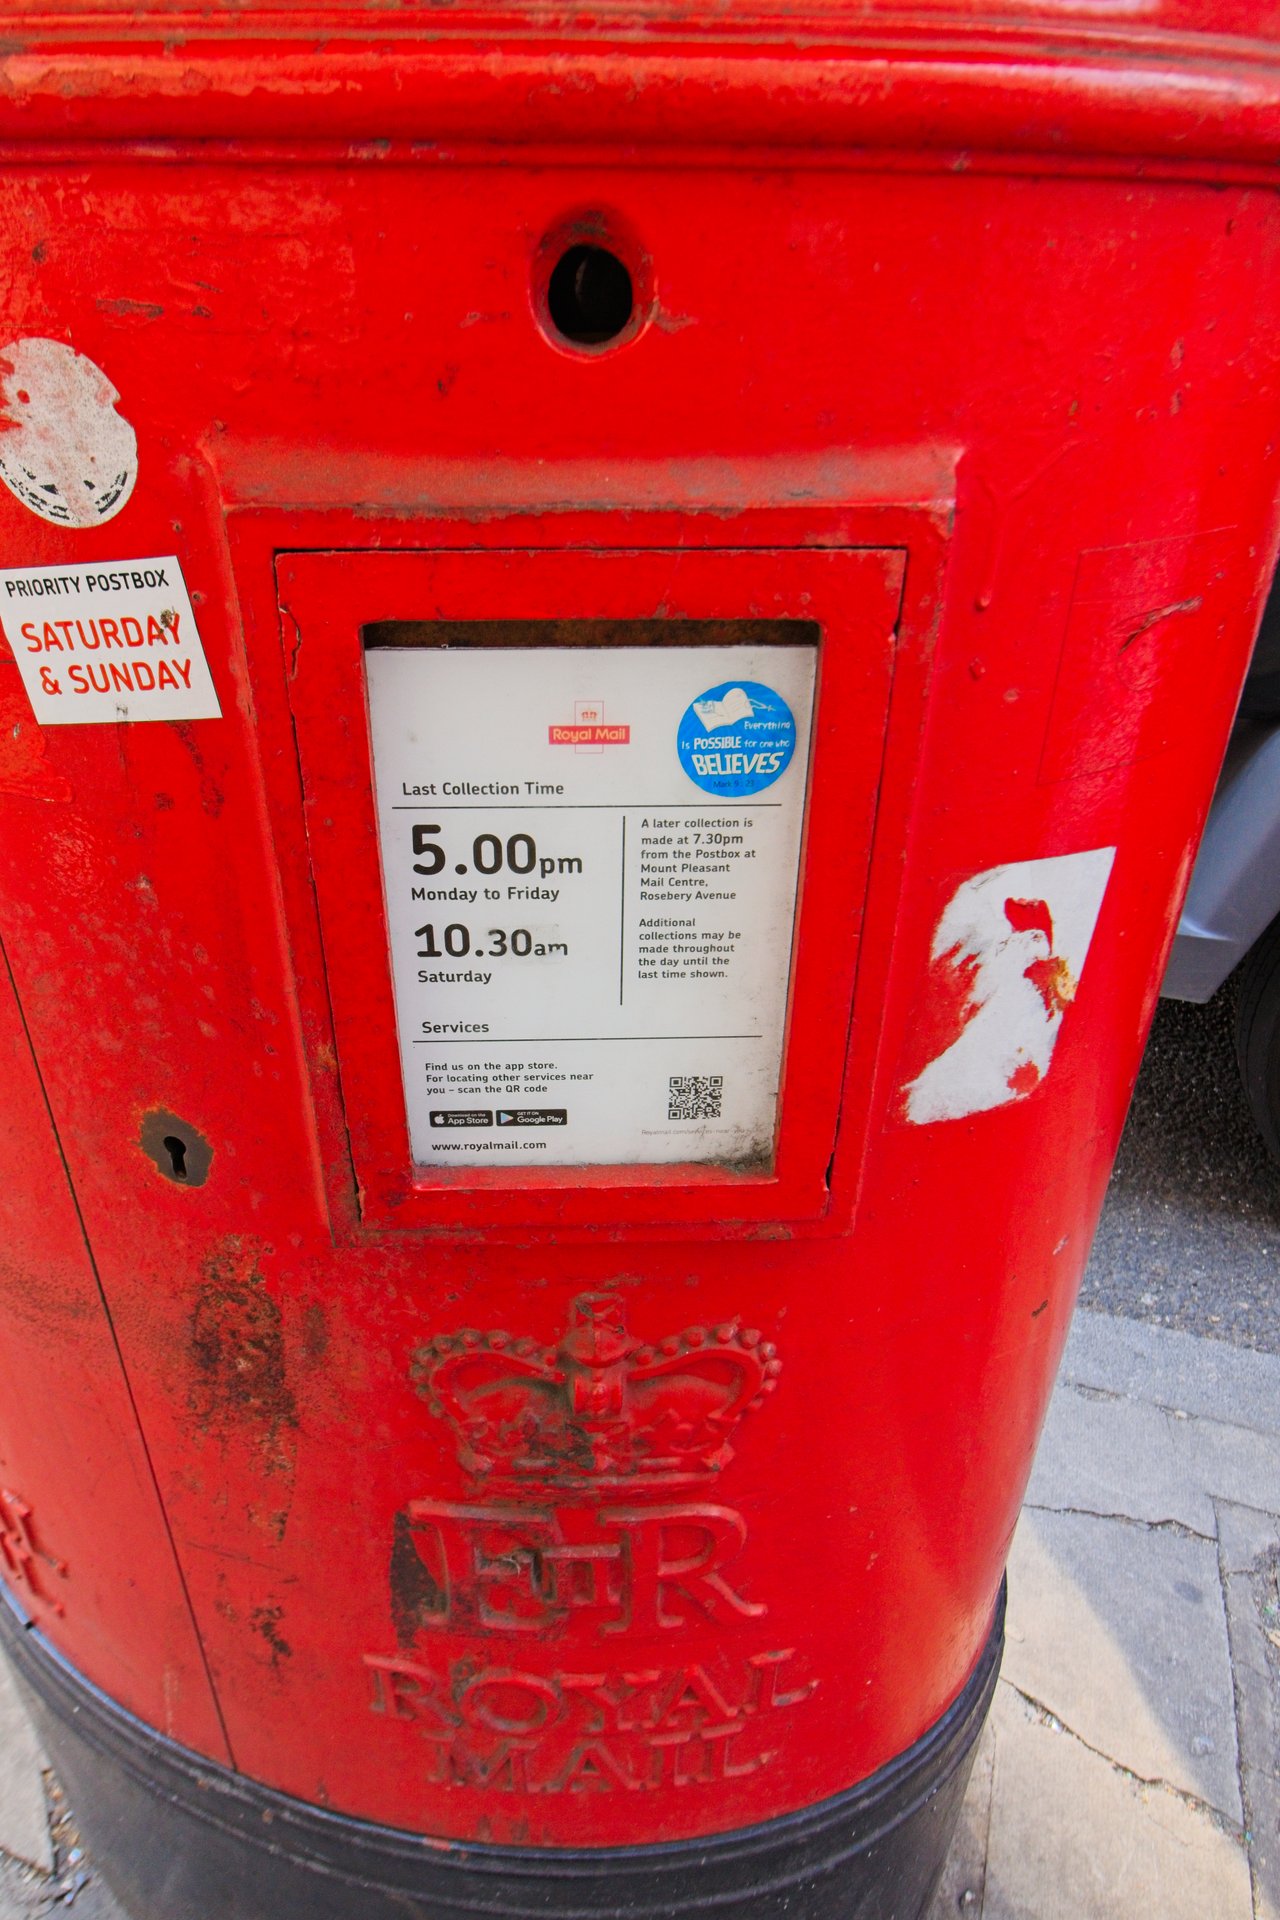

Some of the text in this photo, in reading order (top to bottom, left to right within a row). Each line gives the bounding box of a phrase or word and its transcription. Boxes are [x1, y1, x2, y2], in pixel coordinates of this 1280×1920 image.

[5, 569, 169, 597] PRIORITY POSTBOX
[21, 613, 180, 653] SATURDAY
[40, 659, 191, 695] & SUNDAY
[552, 728, 625, 742] Royal Mail
[694, 736, 742, 750] POSSIBLE
[691, 752, 784, 775] BELIEVES
[402, 782, 564, 796] Last Collection Time
[642, 818, 753, 828] A later collection is
[642, 833, 743, 846] made at 7.30pm
[412, 824, 583, 879] 5.00pm
[641, 849, 756, 859] from the Postbox at
[641, 864, 730, 873] Mount Pleasant
[641, 877, 708, 887] Mail Centre,
[411, 886, 560, 903] Monday to Friday
[640, 891, 736, 902] Rosebery Avenue
[639, 918, 696, 927] Additional
[414, 923, 568, 957] 10.30am
[639, 931, 741, 941] collections may be
[639, 944, 735, 954] made throughout
[639, 957, 730, 967] the day until the
[418, 970, 492, 984] Saturday
[638, 970, 727, 979] last time shown.
[422, 1021, 489, 1033] Services
[425, 1063, 448, 1071] Find
[484, 1062, 501, 1070] the
[505, 1063, 524, 1071] app
[528, 1062, 558, 1070] store.
[426, 1073, 594, 1083] For locating other services near
[427, 1086, 445, 1095] you
[458, 1086, 481, 1094] scan
[485, 1085, 501, 1093] the
[506, 1085, 520, 1093] QR
[524, 1085, 548, 1093] code
[517, 1116, 545, 1124] Google
[432, 1141, 546, 1152] www.royalmail.com
[361, 1646, 821, 1732] ROYAL
[421, 1720, 779, 1794] MAIL
